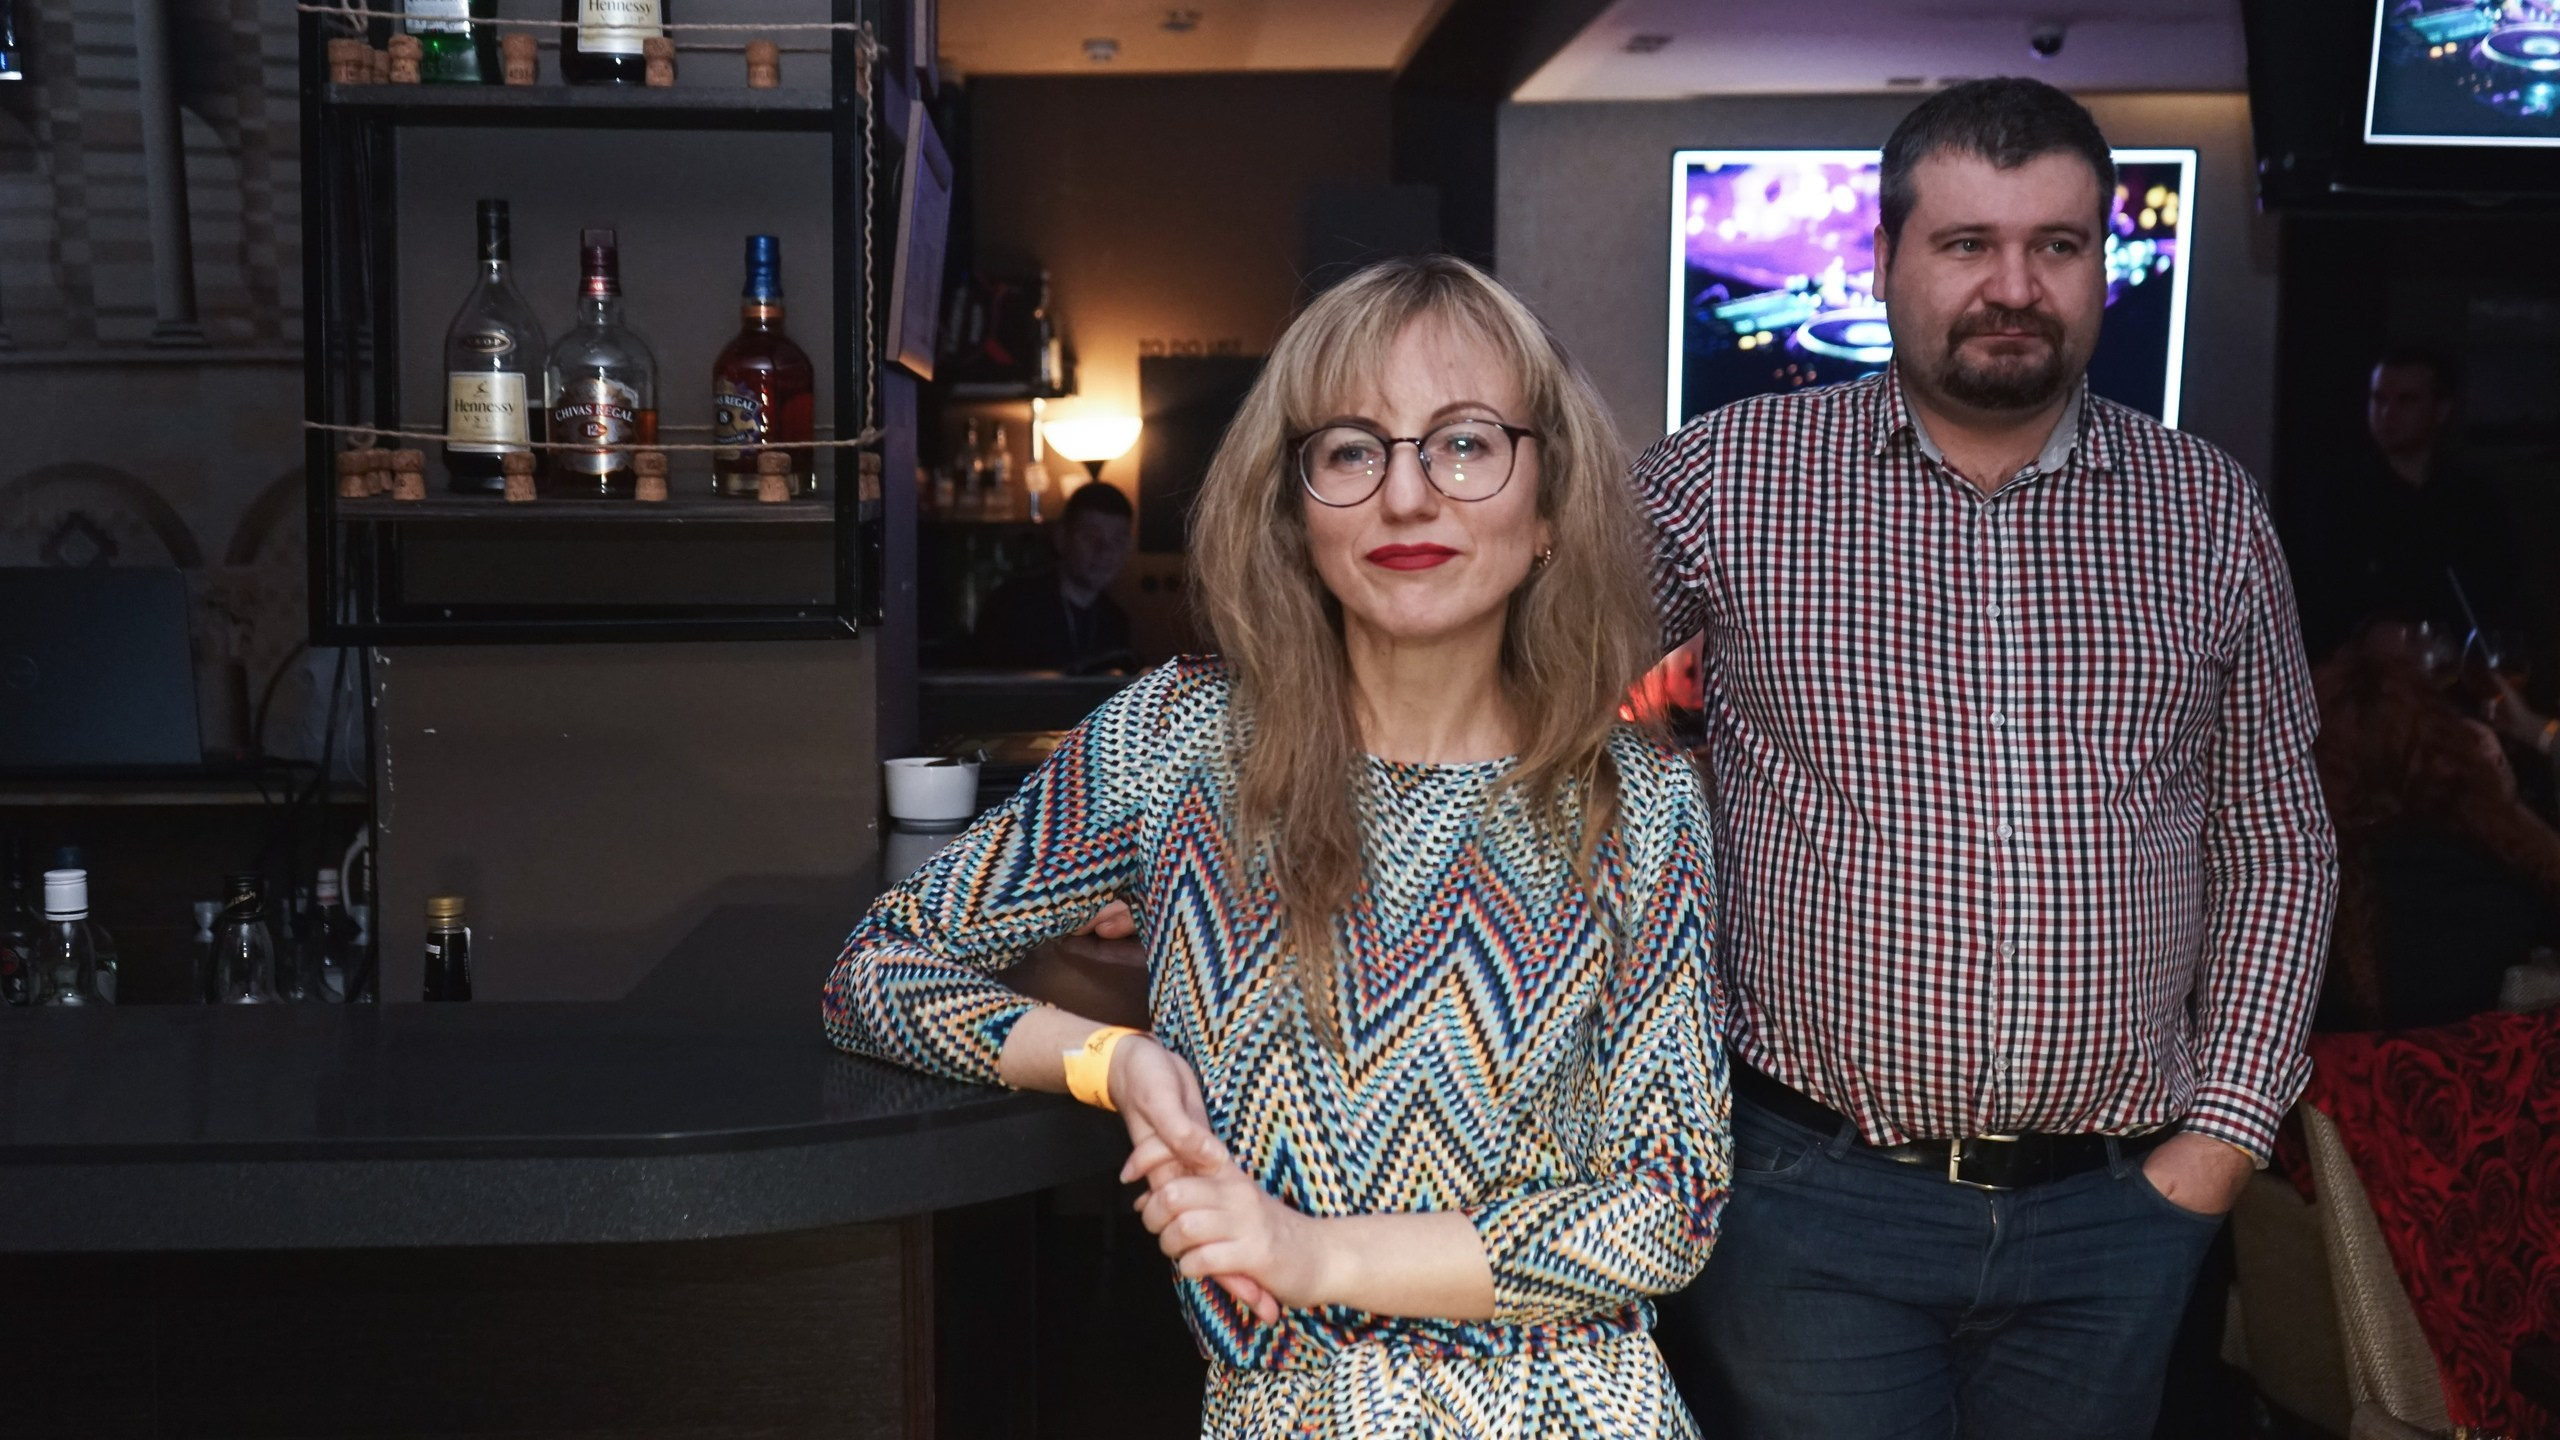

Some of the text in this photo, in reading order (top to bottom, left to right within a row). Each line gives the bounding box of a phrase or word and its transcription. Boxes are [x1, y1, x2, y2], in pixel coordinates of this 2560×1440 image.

[588, 0, 652, 16] Hennessy
[454, 399, 514, 416] Hennessy
[724, 395, 754, 412] REGAL
[555, 404, 633, 423] CHIVAS REGAL
